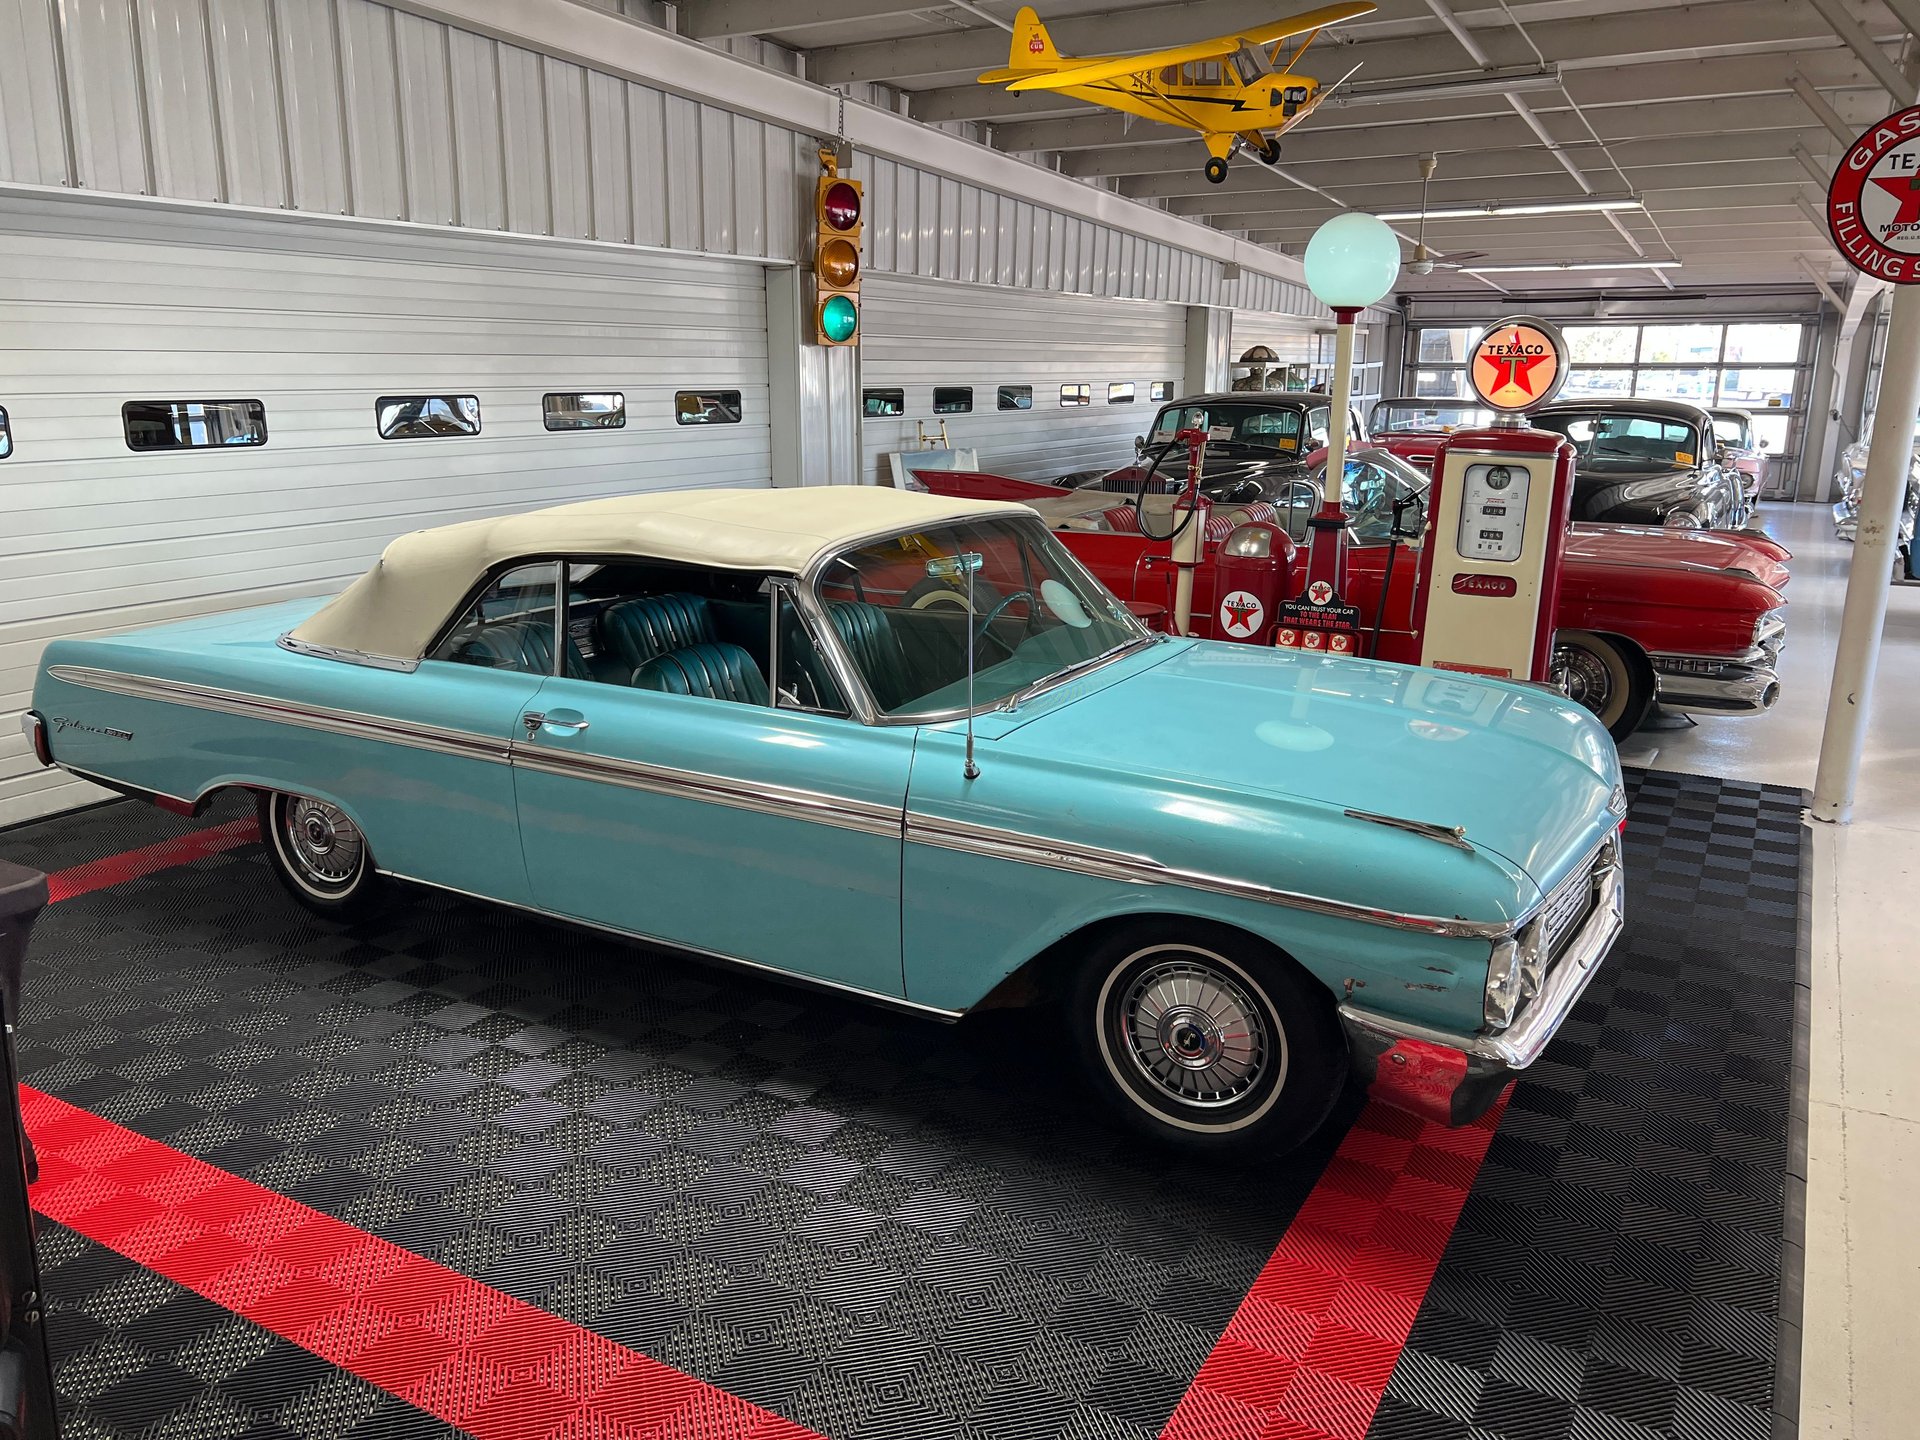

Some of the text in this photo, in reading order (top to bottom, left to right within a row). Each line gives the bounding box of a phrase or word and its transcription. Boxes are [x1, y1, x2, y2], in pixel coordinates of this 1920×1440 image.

[1889, 153, 1920, 170] TE
[1836, 202, 1905, 277] FILLING
[1488, 344, 1544, 355] TEXACO
[1463, 579, 1506, 590] TEXACO
[1227, 600, 1256, 608] TEXACO
[1300, 618, 1321, 626] WEARS
